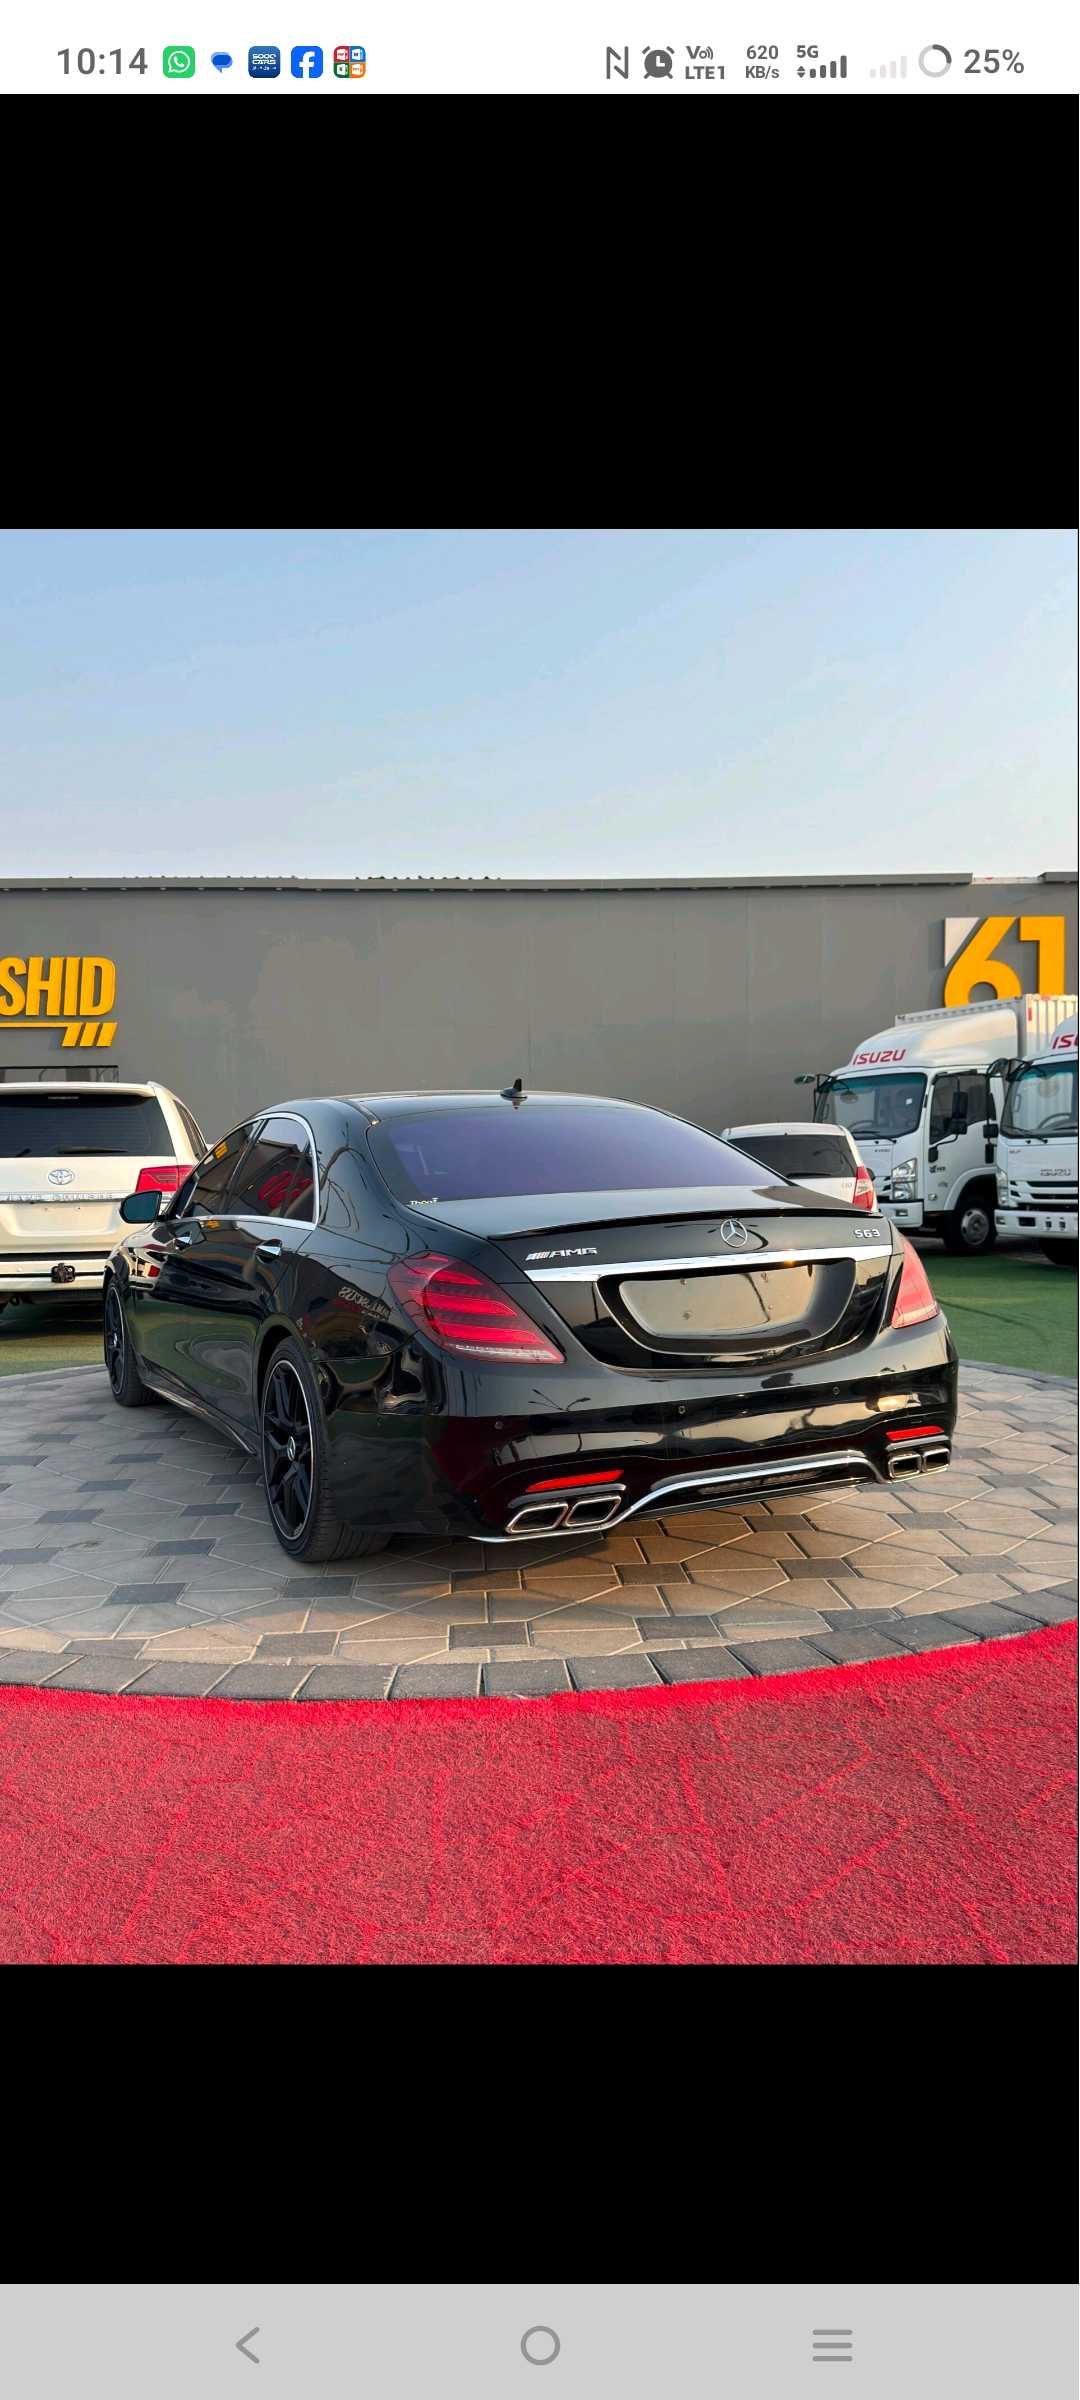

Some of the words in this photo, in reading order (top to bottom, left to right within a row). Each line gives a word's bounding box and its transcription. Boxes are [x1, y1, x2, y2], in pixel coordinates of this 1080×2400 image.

[944, 916, 1065, 1009] 61
[0, 957, 116, 1016] SHID
[852, 1048, 907, 1066] ISUZU
[855, 1228, 881, 1240] S63
[549, 1246, 598, 1259] AMG
